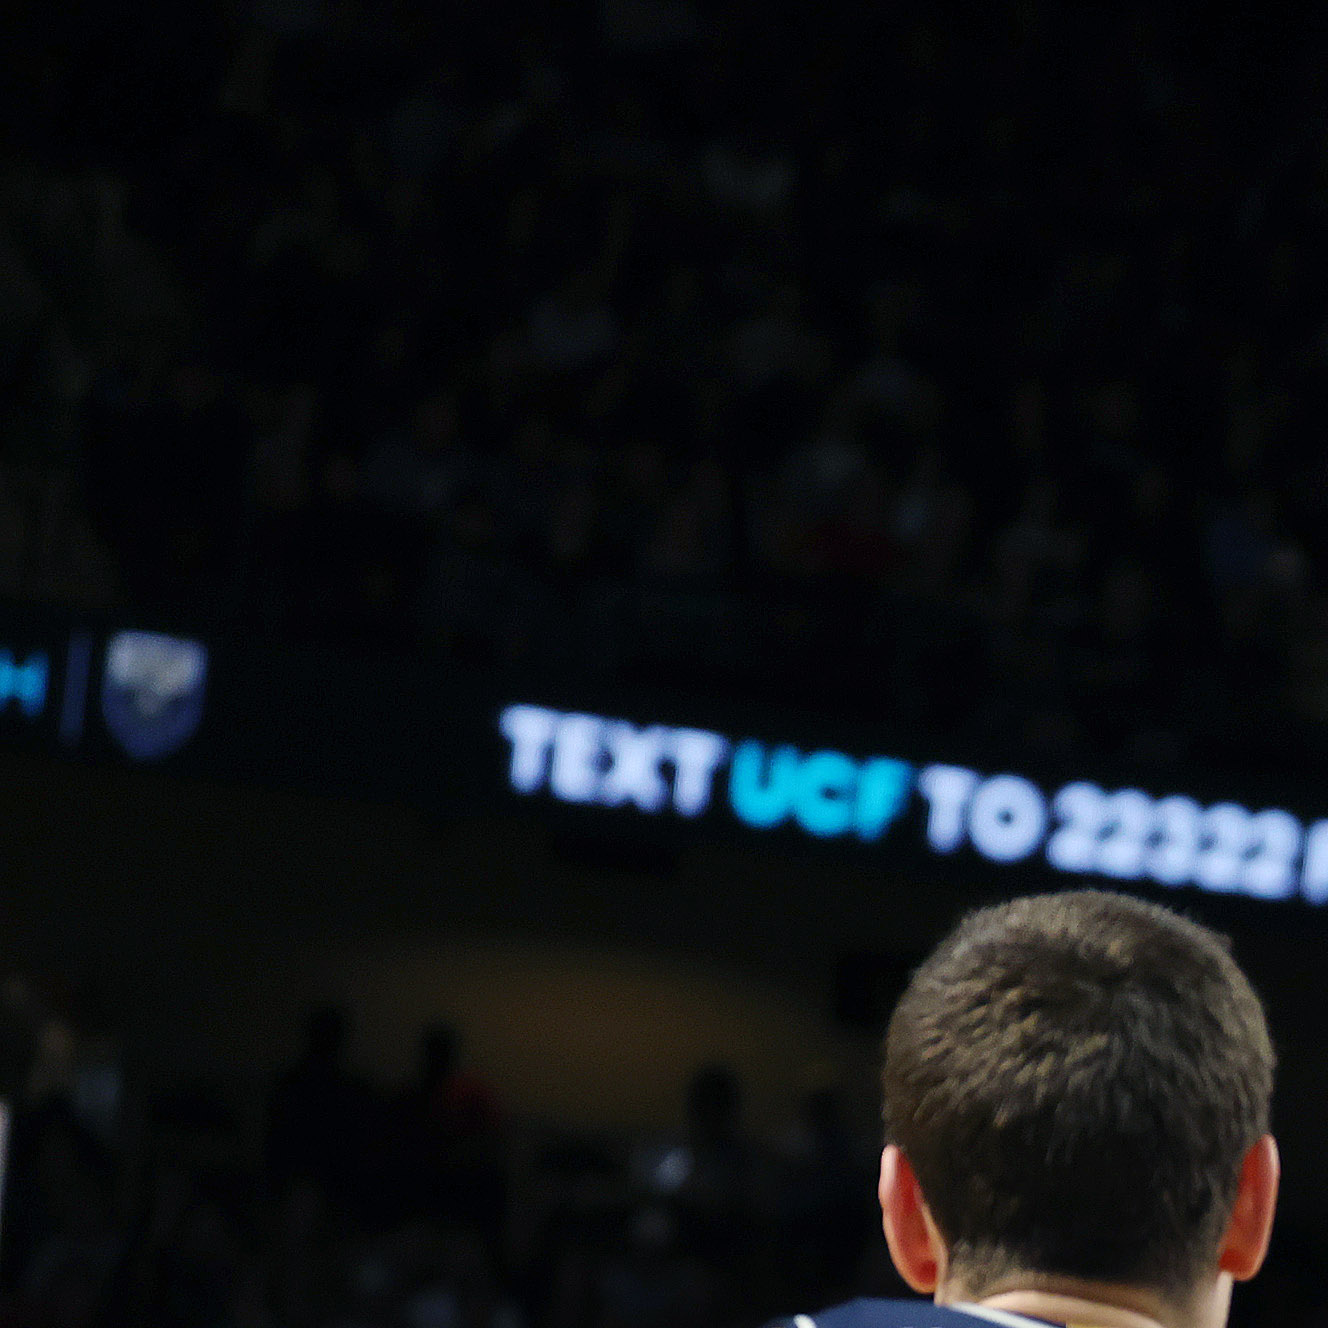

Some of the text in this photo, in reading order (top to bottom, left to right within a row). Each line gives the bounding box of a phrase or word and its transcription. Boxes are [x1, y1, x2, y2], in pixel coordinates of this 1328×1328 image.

[501, 704, 728, 818] TEXT
[730, 738, 913, 841] UCF
[920, 764, 1047, 862] TO
